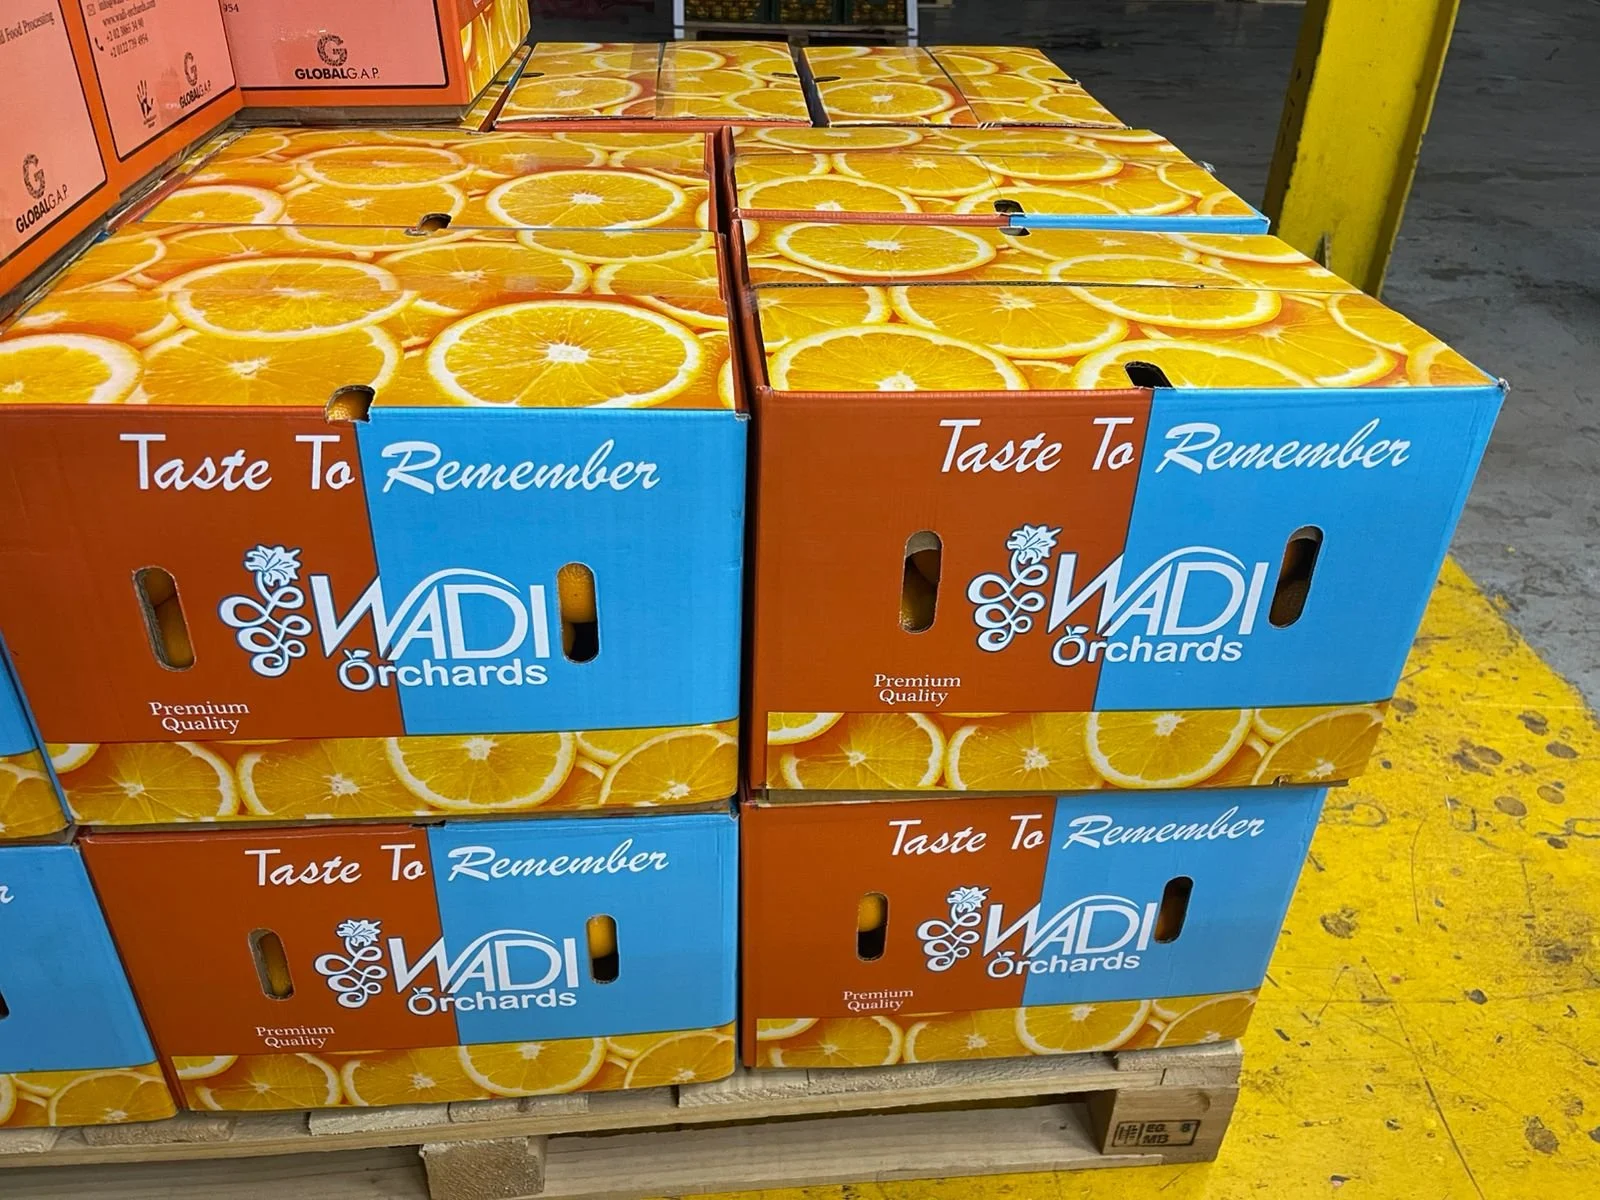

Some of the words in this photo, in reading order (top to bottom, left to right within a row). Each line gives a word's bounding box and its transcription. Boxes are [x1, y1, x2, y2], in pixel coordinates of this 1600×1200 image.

[5, 21, 23, 42] Food
[939, 418, 1063, 474] Taste
[1091, 416, 1136, 472] To
[1154, 418, 1412, 475] Remember
[118, 433, 272, 492] Taste
[294, 434, 356, 491] To
[381, 439, 661, 495] Remember
[1046, 545, 1270, 637] WADI
[309, 568, 551, 660] WADI
[1051, 626, 1243, 667] Orchards
[338, 649, 549, 692] Orchards
[873, 673, 962, 689] Premium
[148, 701, 250, 718] Premium
[878, 688, 949, 707] Quality
[161, 716, 241, 735] Quality
[888, 819, 987, 857] Taste
[1009, 813, 1046, 851] To
[1062, 806, 1266, 851] Remember
[244, 848, 362, 887] Taste
[380, 843, 427, 882] To
[447, 838, 670, 883] Remember
[982, 894, 1158, 958] WADI
[387, 929, 579, 994] WADI
[986, 951, 1141, 979] Orchards
[407, 987, 577, 1016] Orchards
[843, 989, 914, 1001] Premium
[847, 999, 904, 1012] Quality
[255, 1025, 336, 1037] Premium
[264, 1035, 328, 1049] Quality
